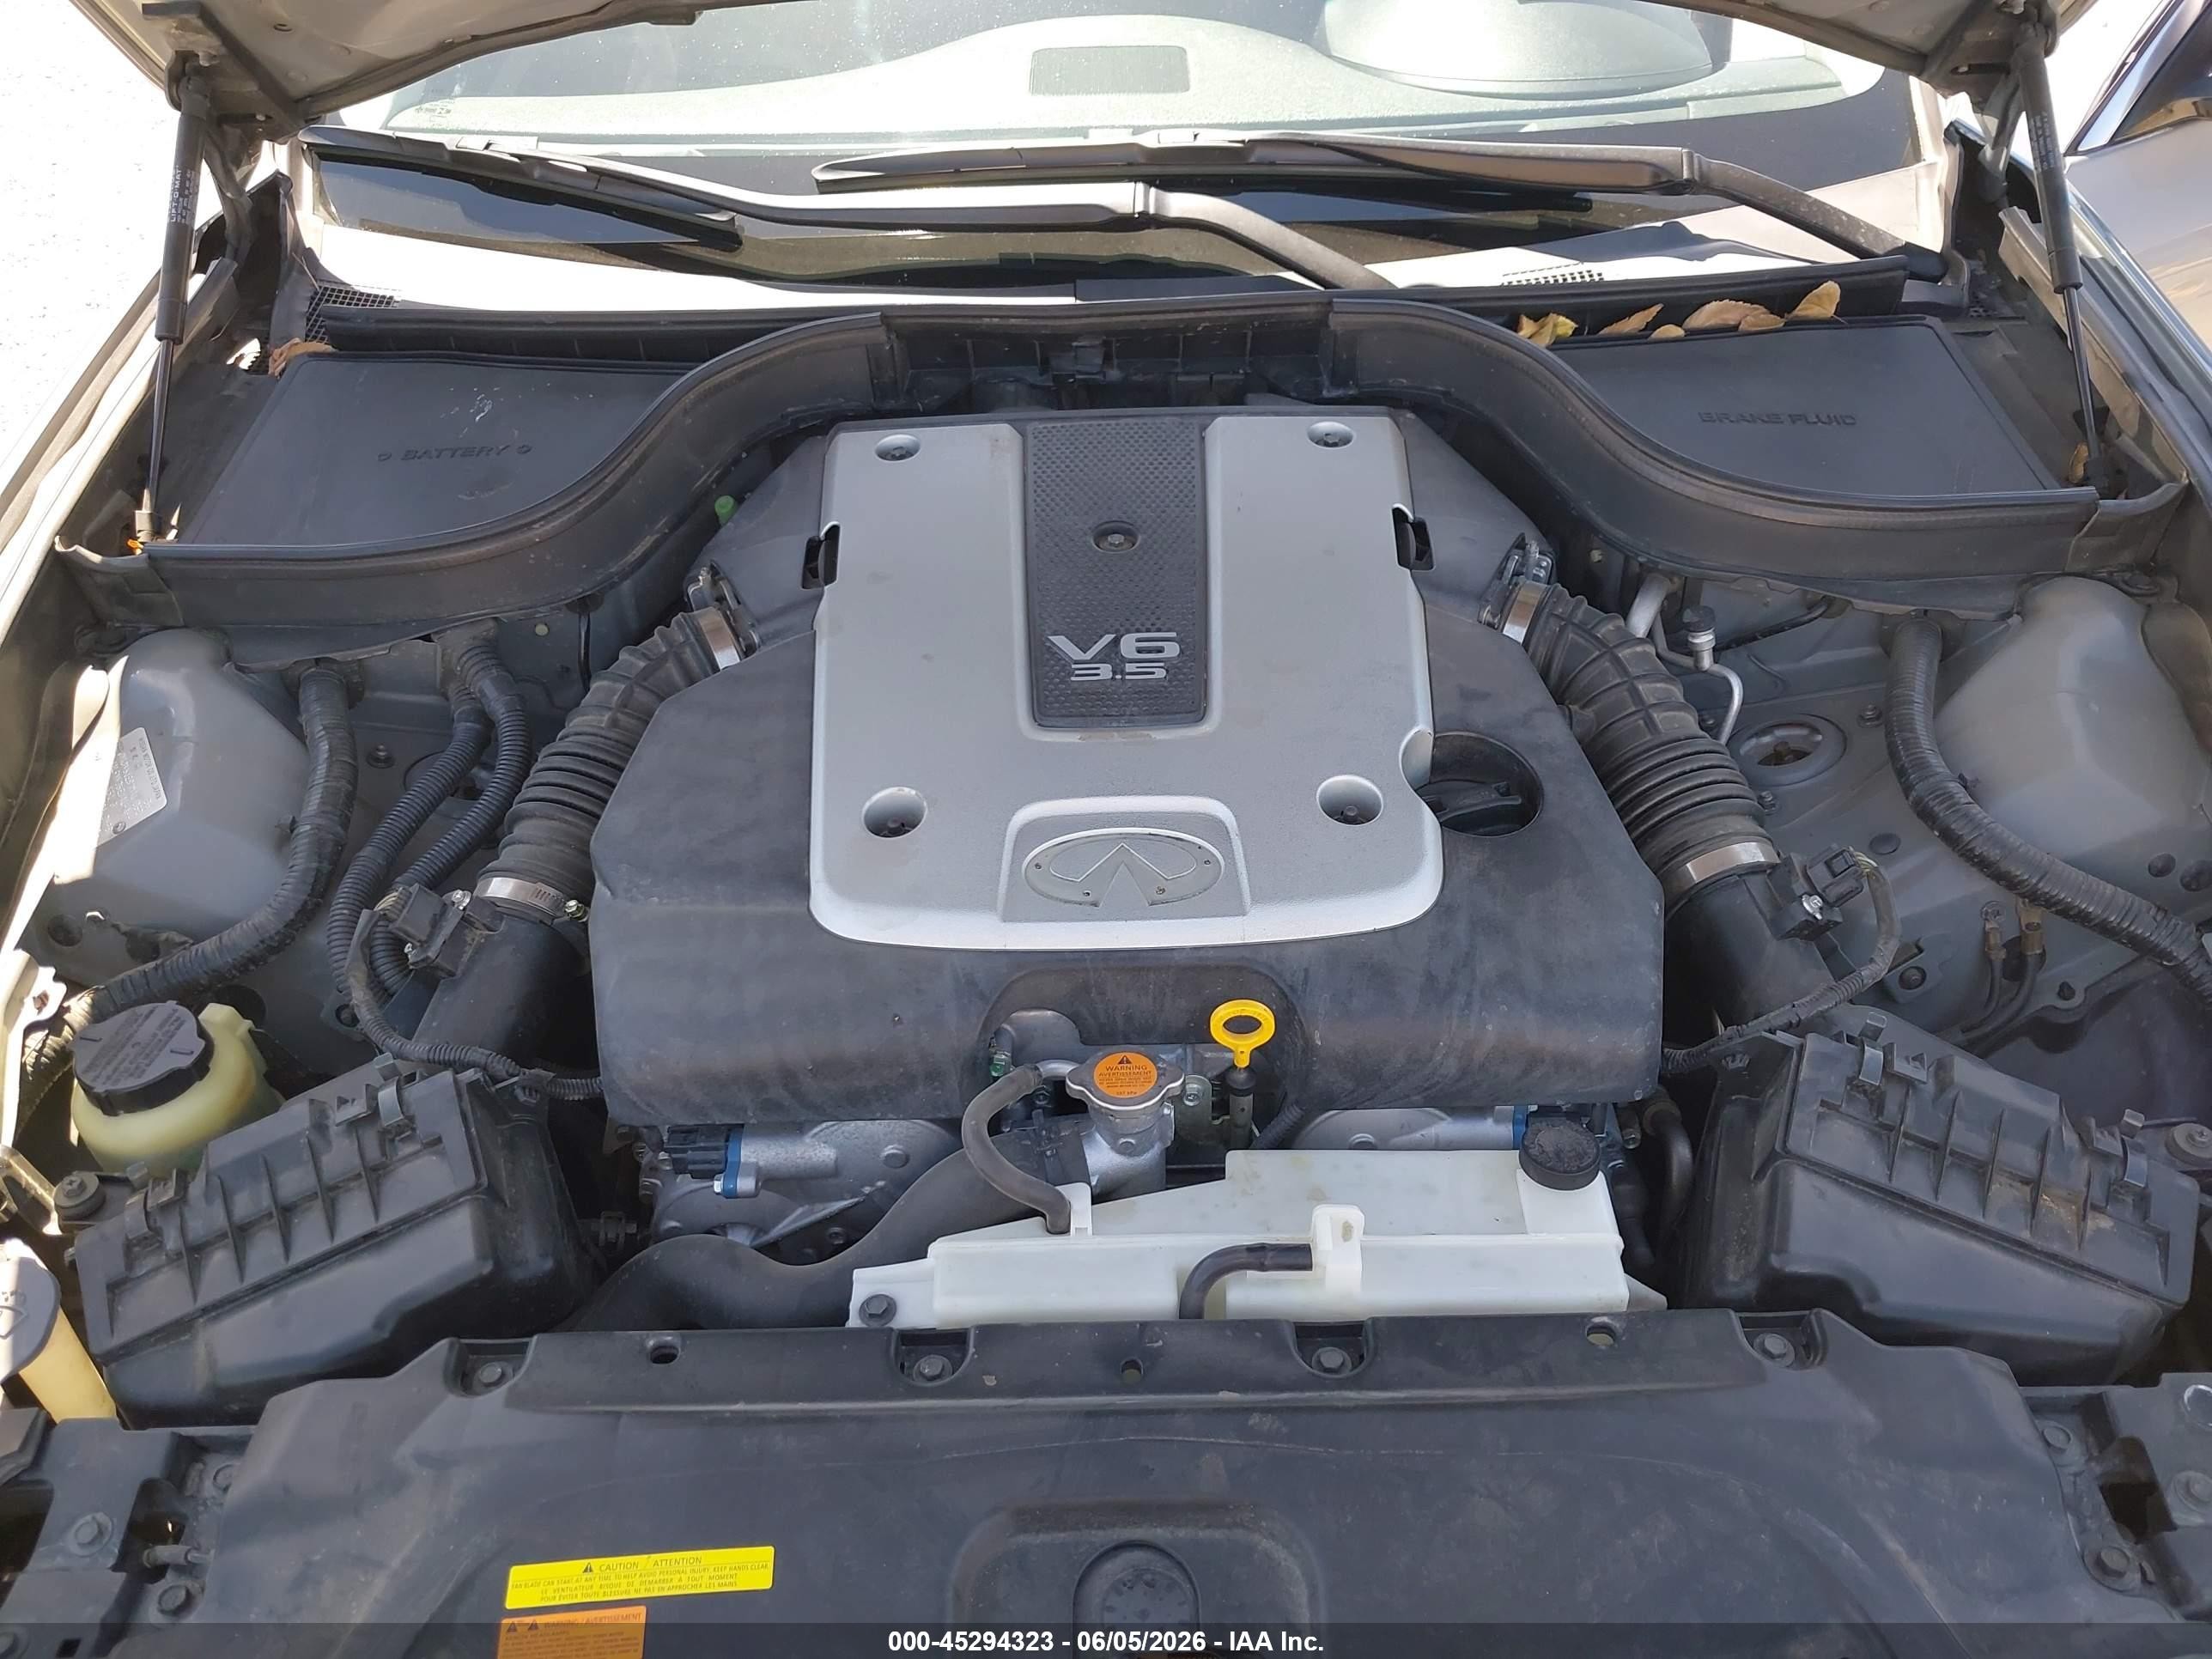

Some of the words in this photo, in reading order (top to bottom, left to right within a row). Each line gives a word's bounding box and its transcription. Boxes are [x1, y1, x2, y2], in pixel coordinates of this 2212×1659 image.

[1698, 411, 1785, 425] BRAKE
[1787, 412, 1857, 427] FLUID
[400, 443, 511, 462] BATTERY
[1048, 631, 1181, 660] V6
[1070, 662, 1167, 681] 3.5
[543, 1578, 556, 1587] CAN
[584, 1575, 596, 1583] ANY
[623, 1571, 636, 1580] HELP
[659, 1567, 687, 1577] PERSONAL
[714, 1565, 727, 1573] KEEP
[728, 1564, 750, 1572] HANDS
[750, 1562, 769, 1571] CLEAR
[599, 1561, 640, 1572] CAUTION
[653, 1556, 702, 1568] ATTENTION
[540, 1595, 556, 1603] POUR
[580, 1590, 599, 1600] TOUTE
[603, 1588, 631, 1598] BLESSURE
[644, 1585, 655, 1595] PAS
[667, 1582, 702, 1592] APPROCHER
[705, 1581, 716, 1589] LES
[717, 1579, 738, 1589] MAINS
[552, 1584, 593, 1595] VENTILATEUR
[599, 1582, 621, 1590] RISQUE
[688, 1574, 704, 1583] TOUT
[708, 1572, 738, 1582] MOMENT
